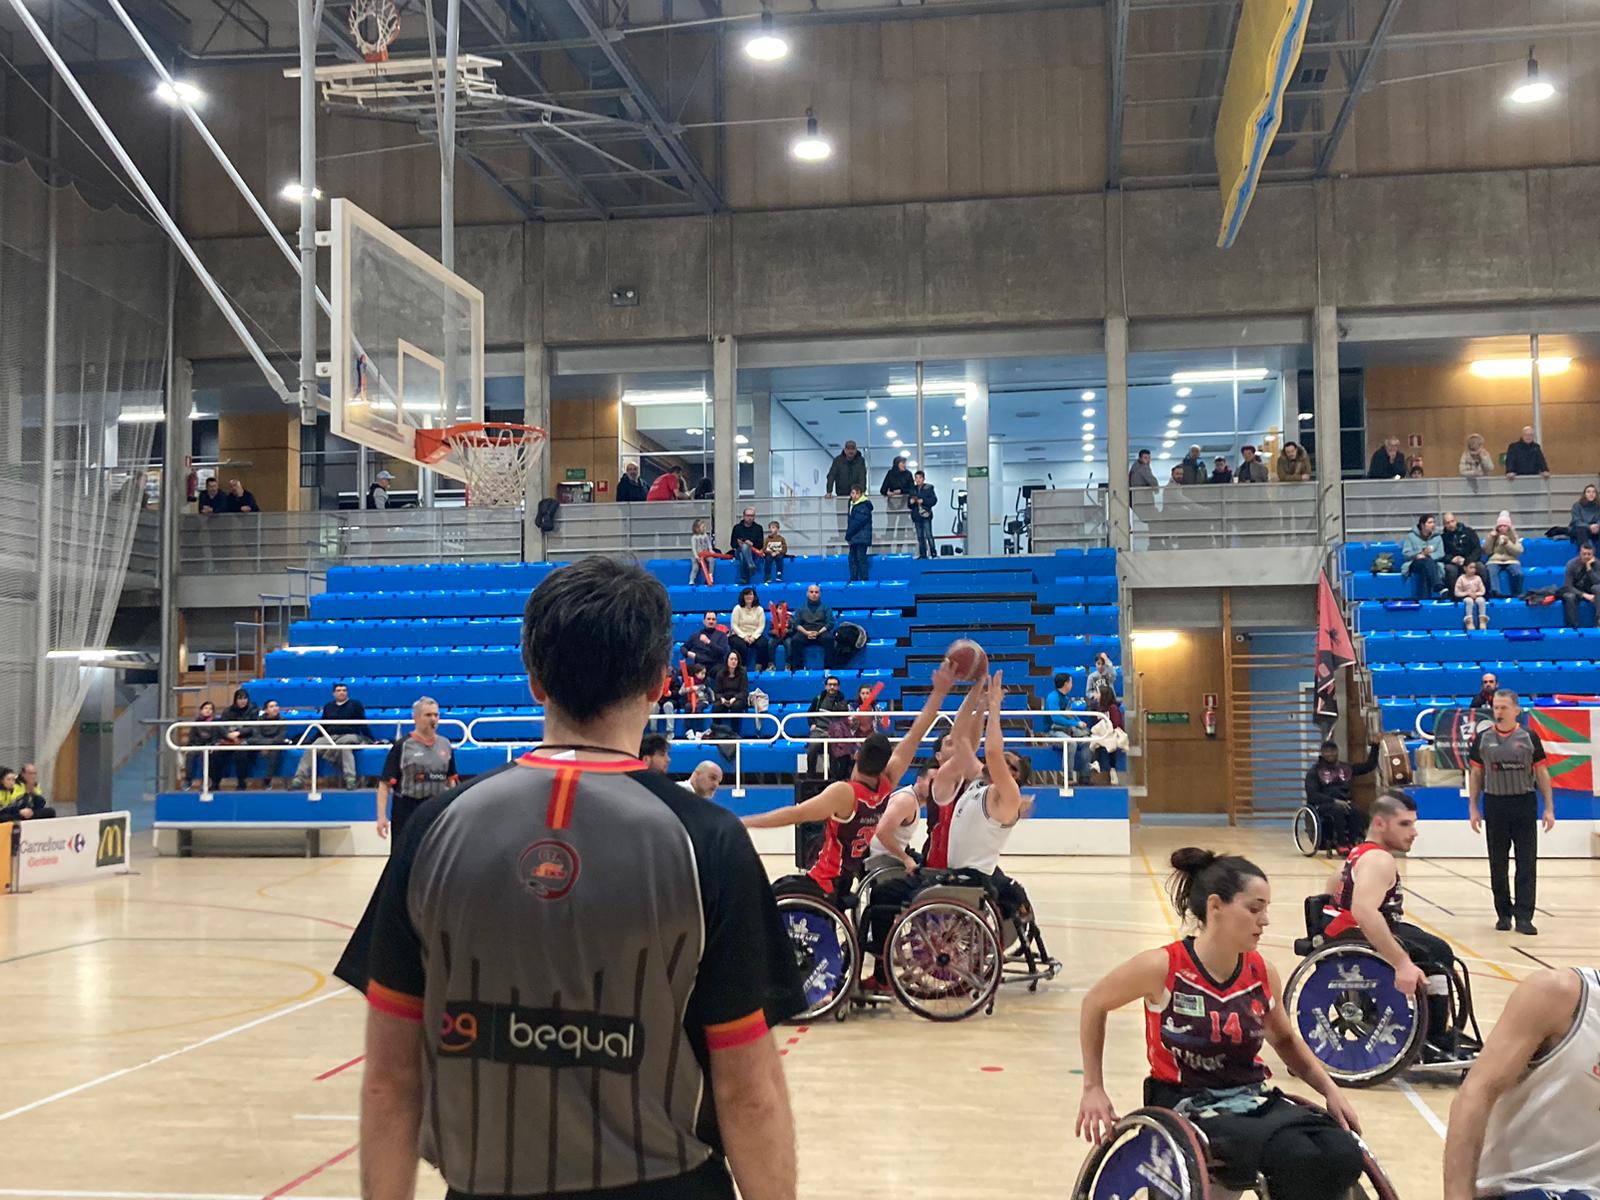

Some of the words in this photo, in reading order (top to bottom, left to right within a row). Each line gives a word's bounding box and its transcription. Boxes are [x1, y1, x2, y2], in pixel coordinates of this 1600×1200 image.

[20, 837, 66, 854] Carrefour
[509, 1012, 635, 1059] bequal
[1209, 1011, 1243, 1044] 14
